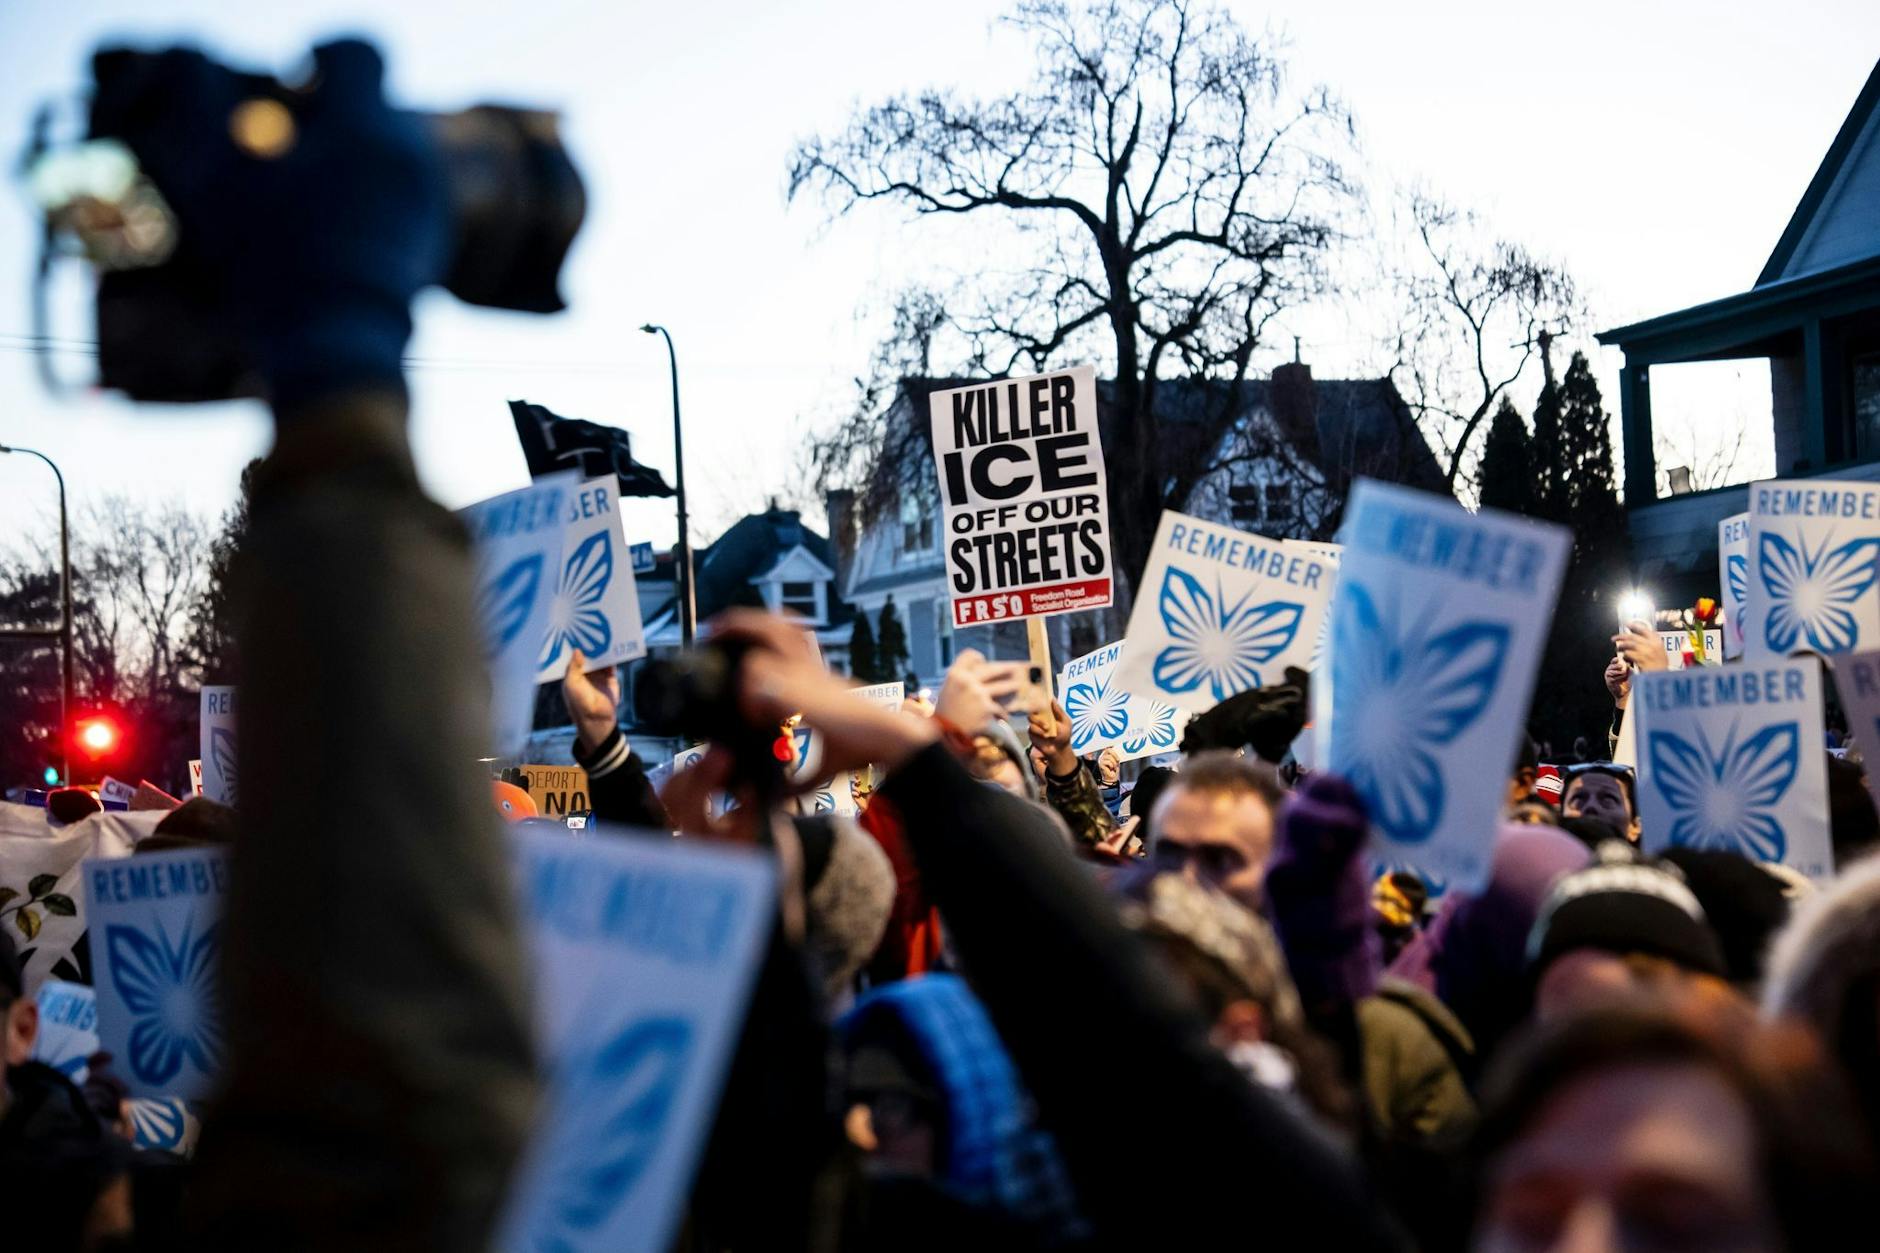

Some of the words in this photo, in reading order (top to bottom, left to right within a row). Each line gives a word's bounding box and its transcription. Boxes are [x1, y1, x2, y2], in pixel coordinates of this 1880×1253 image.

[953, 375, 1076, 449] KILLER
[944, 432, 1098, 506] ICE
[952, 505, 1018, 533] OFF
[1025, 494, 1100, 522] OUR
[1758, 490, 1880, 519] REMEMBE
[951, 519, 1104, 593] STREETS
[1169, 523, 1323, 590] REMEMBER
[1064, 587, 1085, 597] Road
[527, 771, 580, 789] DEPORT
